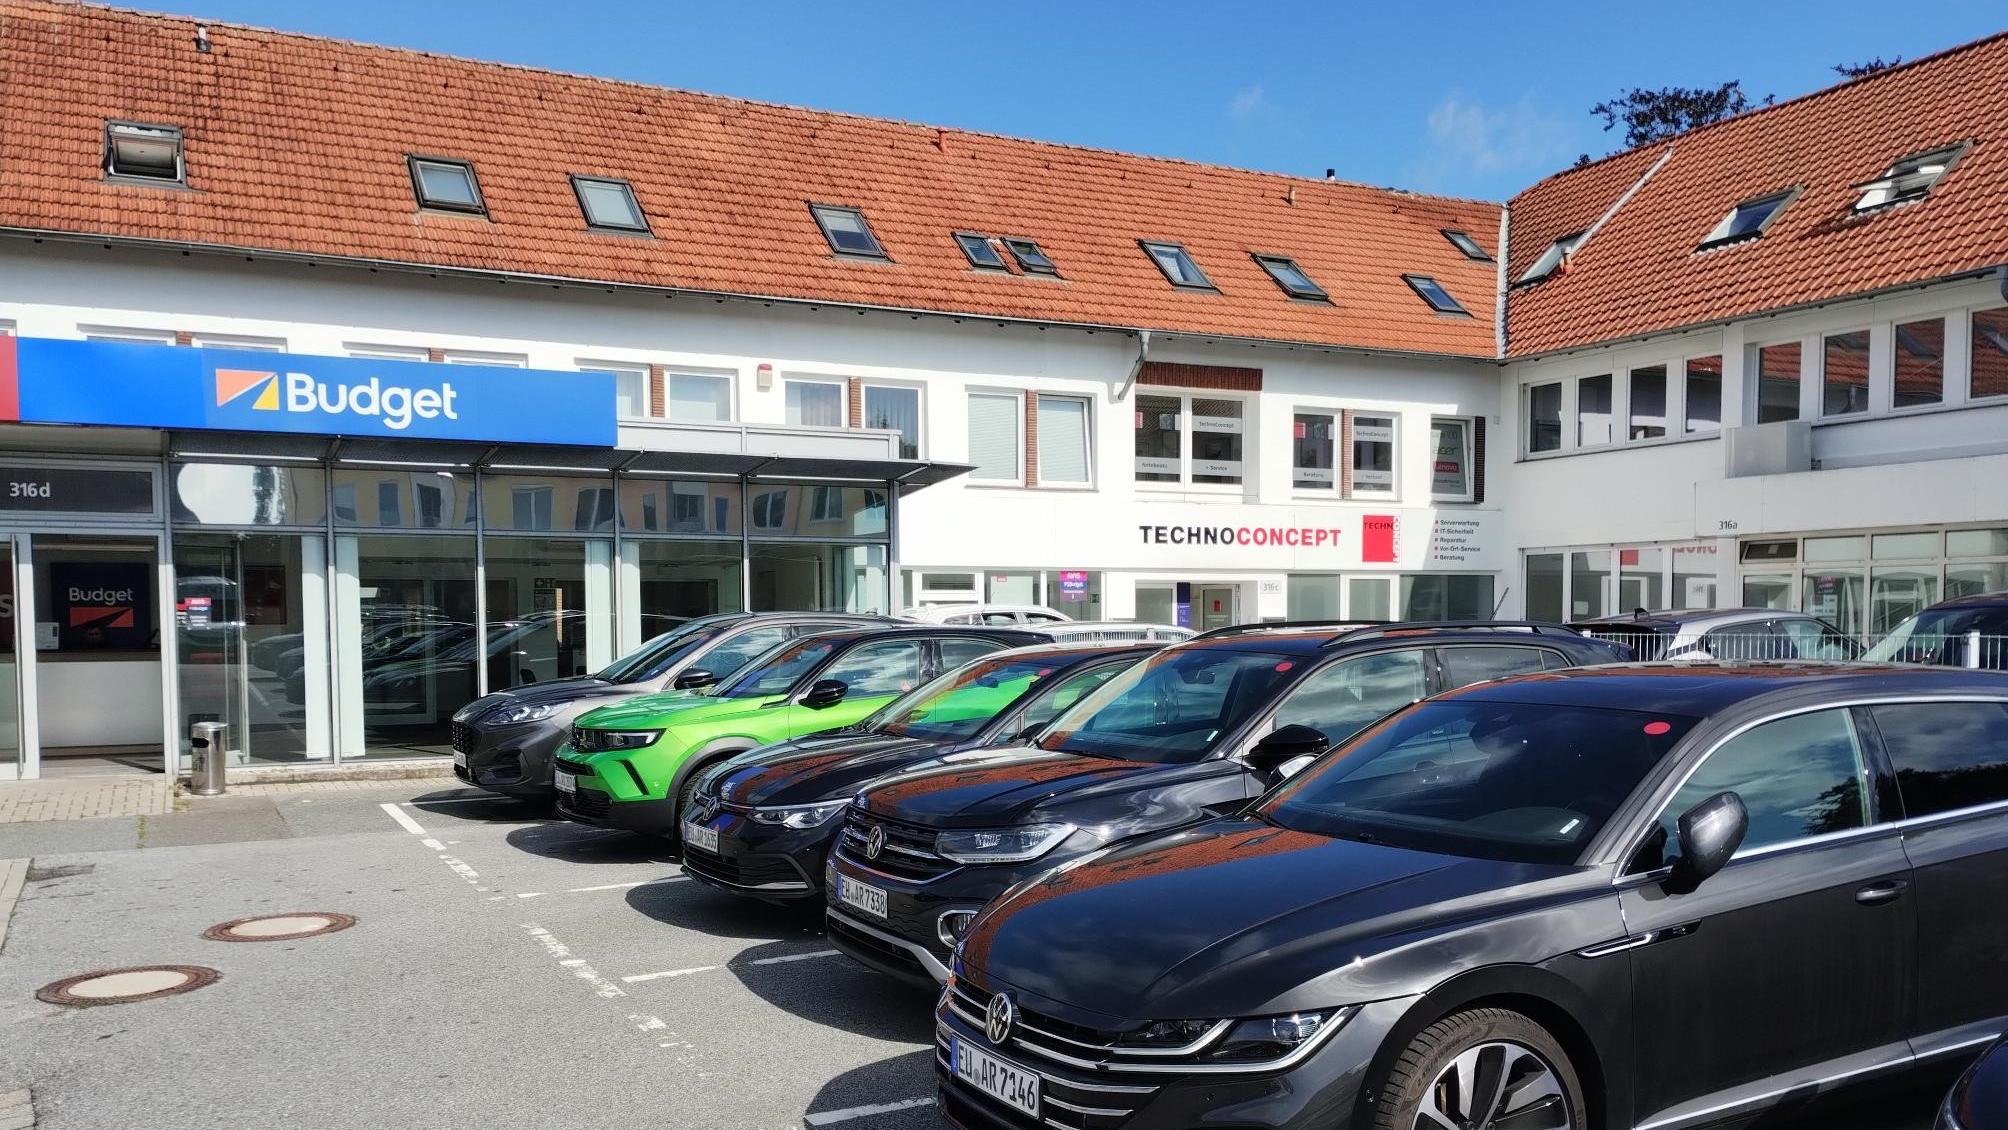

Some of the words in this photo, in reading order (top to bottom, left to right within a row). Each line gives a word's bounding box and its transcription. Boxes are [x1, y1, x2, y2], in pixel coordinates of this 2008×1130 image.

[286, 371, 458, 430] Budget
[9, 481, 51, 498] 316d
[1139, 525, 1342, 547] TECHNOCONCEPT
[1719, 520, 1738, 530] 316a
[68, 587, 134, 606] Budget
[865, 888, 885, 914] 7338
[981, 1057, 997, 1093] AR
[1000, 1066, 1036, 1111] 7146
